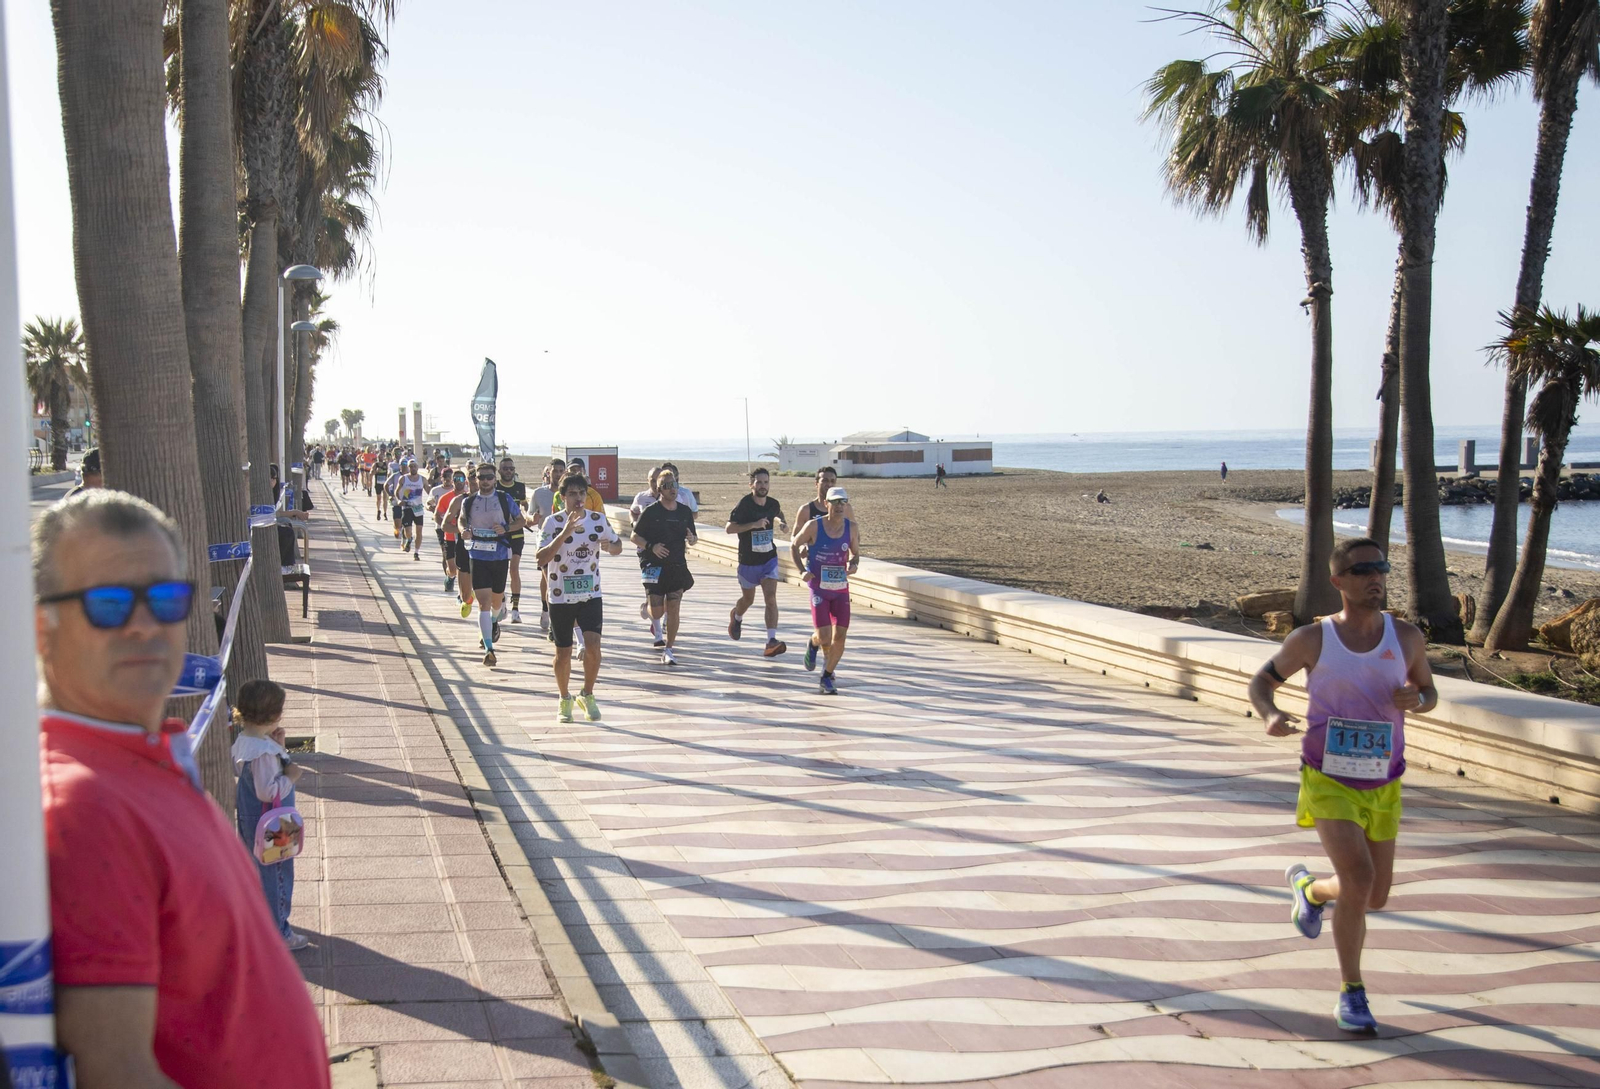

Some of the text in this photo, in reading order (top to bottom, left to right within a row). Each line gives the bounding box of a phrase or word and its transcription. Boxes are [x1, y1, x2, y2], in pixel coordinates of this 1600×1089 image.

[566, 549, 594, 557] kumato
[570, 580, 590, 589] 183
[1335, 730, 1387, 750] 1134
